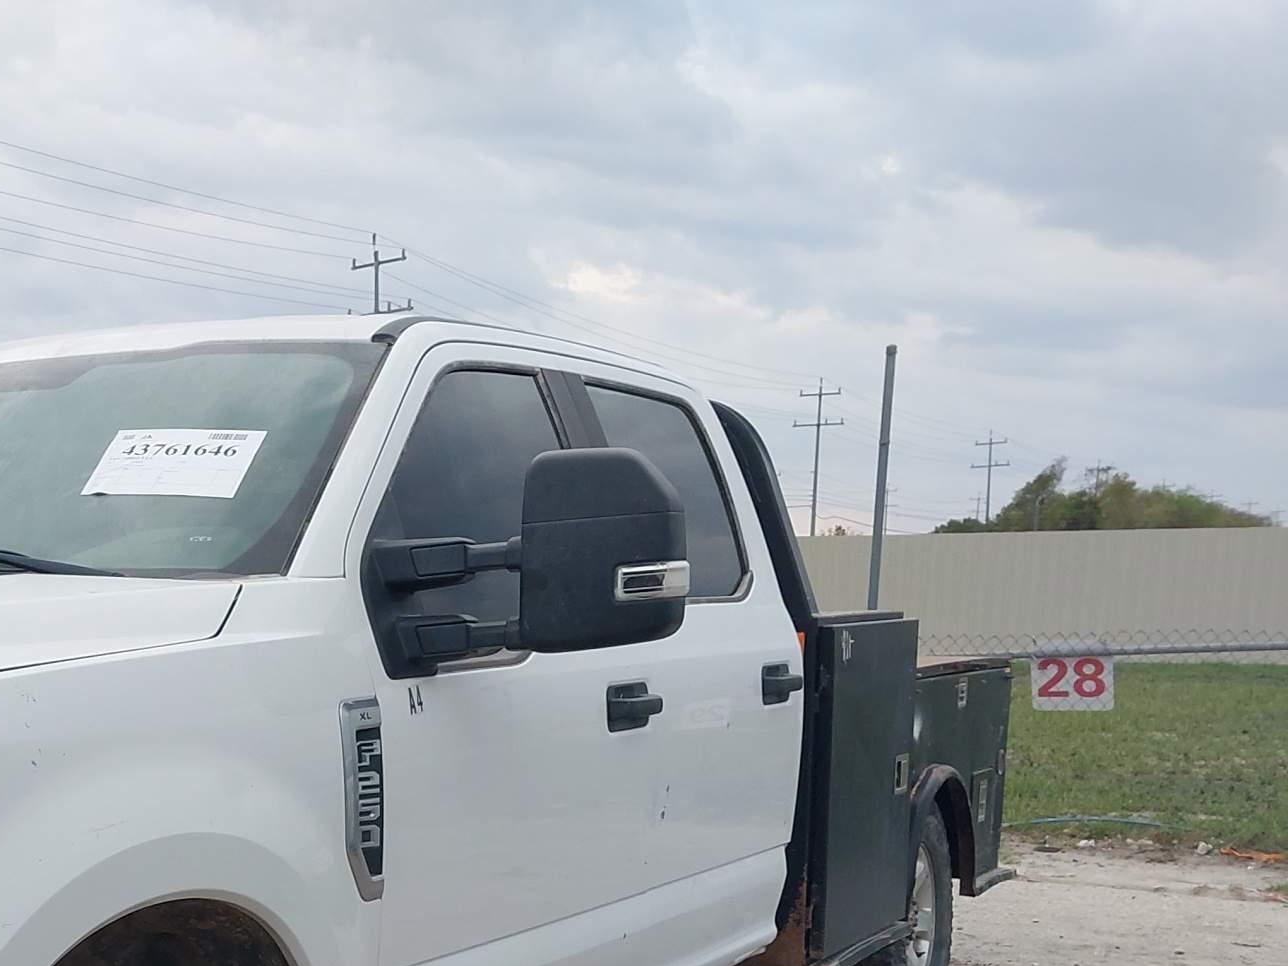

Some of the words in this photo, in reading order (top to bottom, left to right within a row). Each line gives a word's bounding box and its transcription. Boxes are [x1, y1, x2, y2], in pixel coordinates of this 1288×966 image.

[121, 443, 241, 457] 43761646
[1037, 657, 1106, 698] 28
[408, 685, 423, 715] A4
[359, 711, 372, 721] XL
